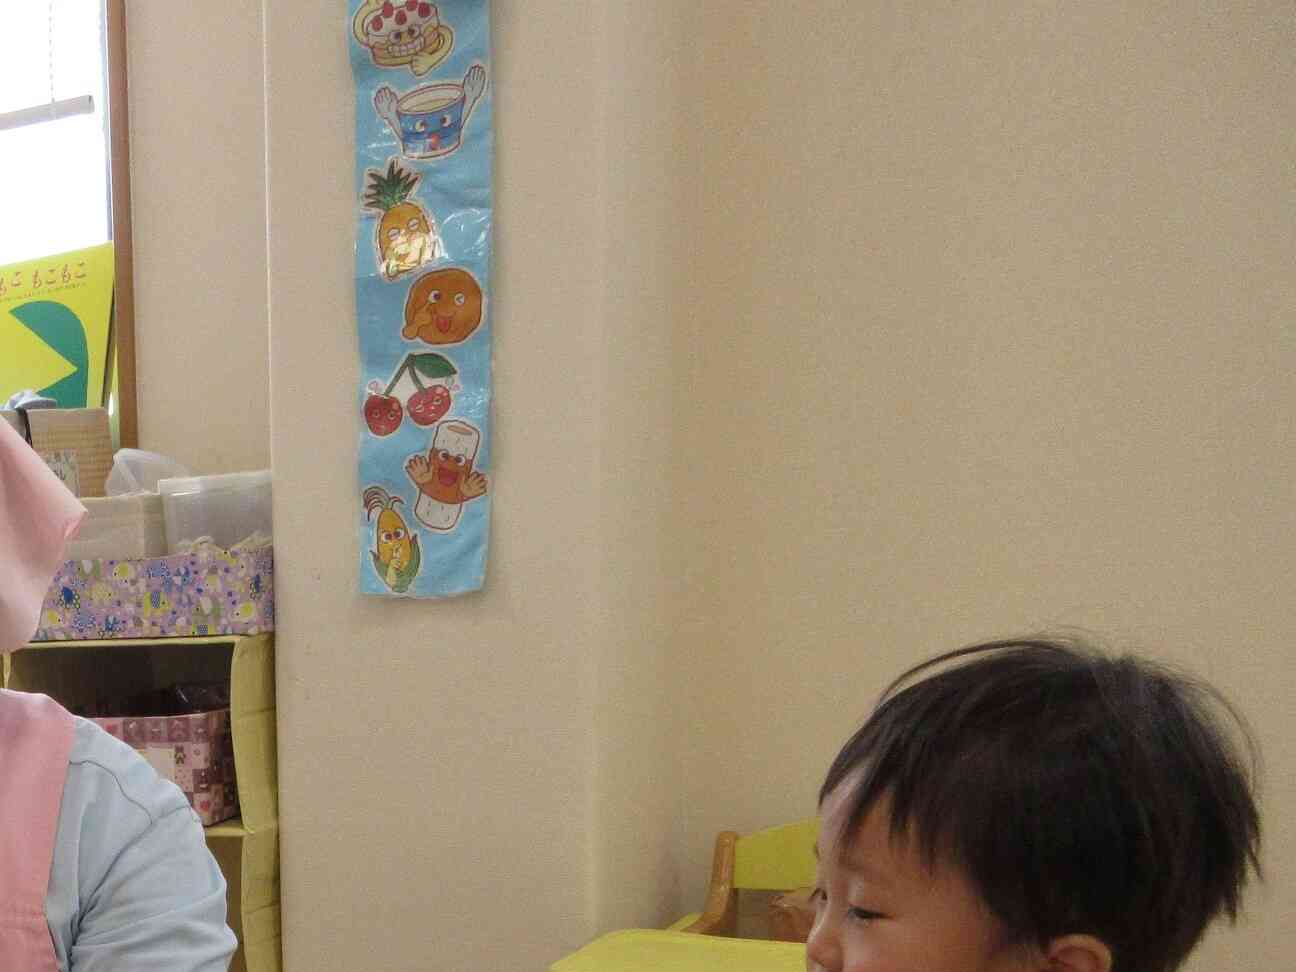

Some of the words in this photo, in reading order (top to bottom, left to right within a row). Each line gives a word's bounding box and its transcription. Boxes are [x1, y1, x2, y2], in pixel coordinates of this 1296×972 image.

[0, 271, 23, 297] もこ
[31, 261, 87, 289] もこもこ
